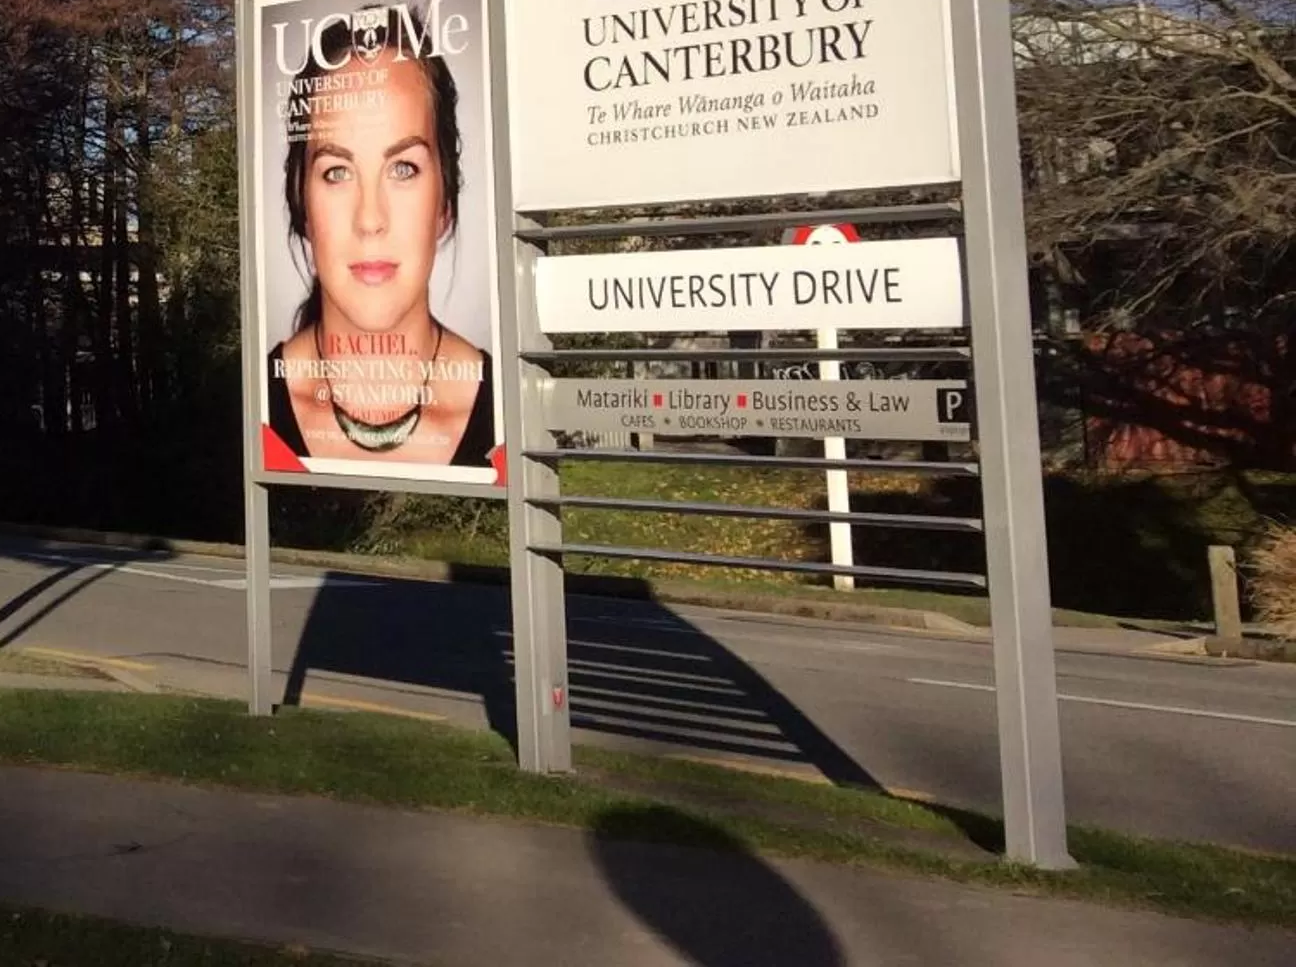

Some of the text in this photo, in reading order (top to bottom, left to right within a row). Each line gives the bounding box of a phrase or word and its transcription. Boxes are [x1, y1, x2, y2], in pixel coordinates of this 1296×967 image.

[272, 13, 353, 76] UC
[583, 20, 874, 92] CANTERBURY
[276, 68, 389, 97] UNIVERSITY OF
[587, 105, 607, 125] Te
[612, 99, 672, 122] Whare
[772, 90, 783, 105] o
[790, 73, 876, 103] Waitaha
[276, 89, 387, 119] CANTERBURY
[587, 103, 880, 146] CHRISTCHURCH NEW ZEALAND
[588, 267, 903, 311] UNIVERSITY DRIVE
[274, 358, 410, 381] REPRESENTING
[577, 388, 648, 410] Matariki
[669, 390, 731, 414] Library
[753, 391, 839, 412] Business
[846, 392, 862, 412] &
[869, 391, 910, 412] Law
[679, 416, 748, 430] BOOKSHOP
[770, 418, 862, 432] RESTAURANTS
